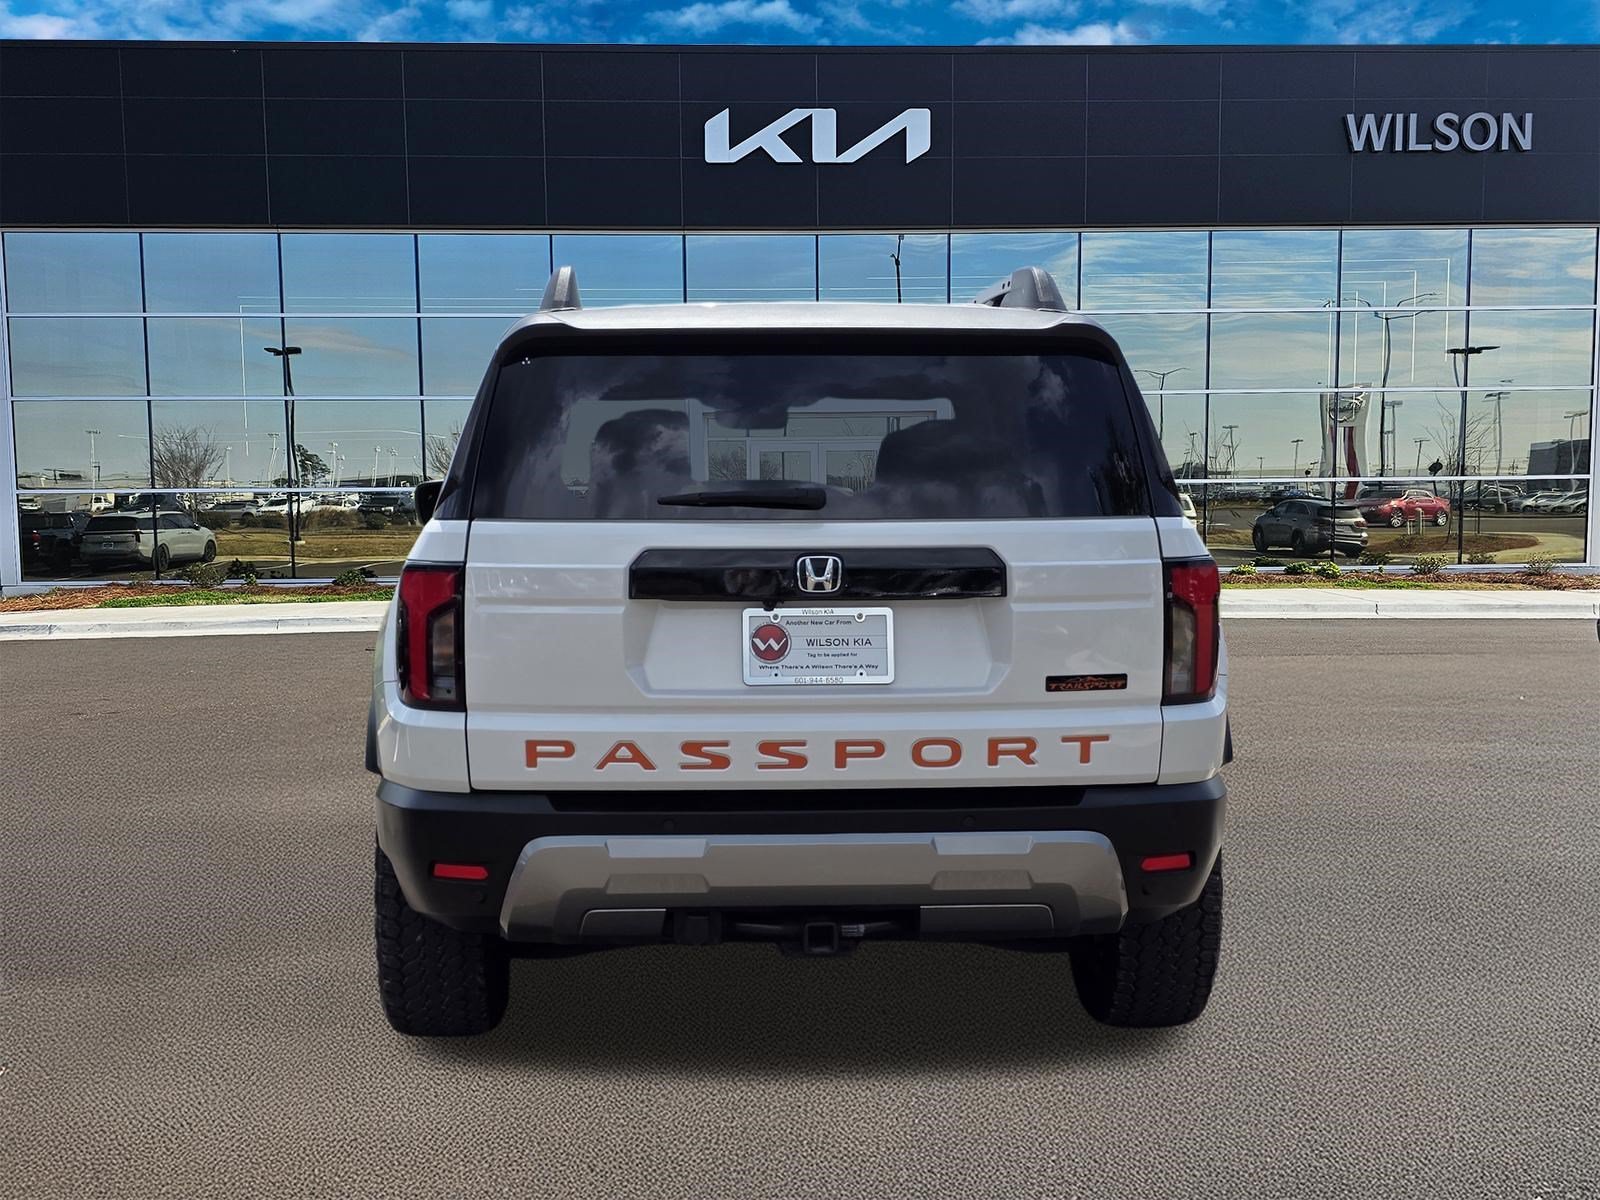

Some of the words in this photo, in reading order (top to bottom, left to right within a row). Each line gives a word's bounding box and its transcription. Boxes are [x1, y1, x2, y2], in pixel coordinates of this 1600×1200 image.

[704, 107, 931, 164] KIA
[1346, 111, 1535, 152] WILSON
[805, 638, 849, 647] WILSON
[853, 637, 872, 646] KIA
[524, 735, 1110, 771] PASSPORT
